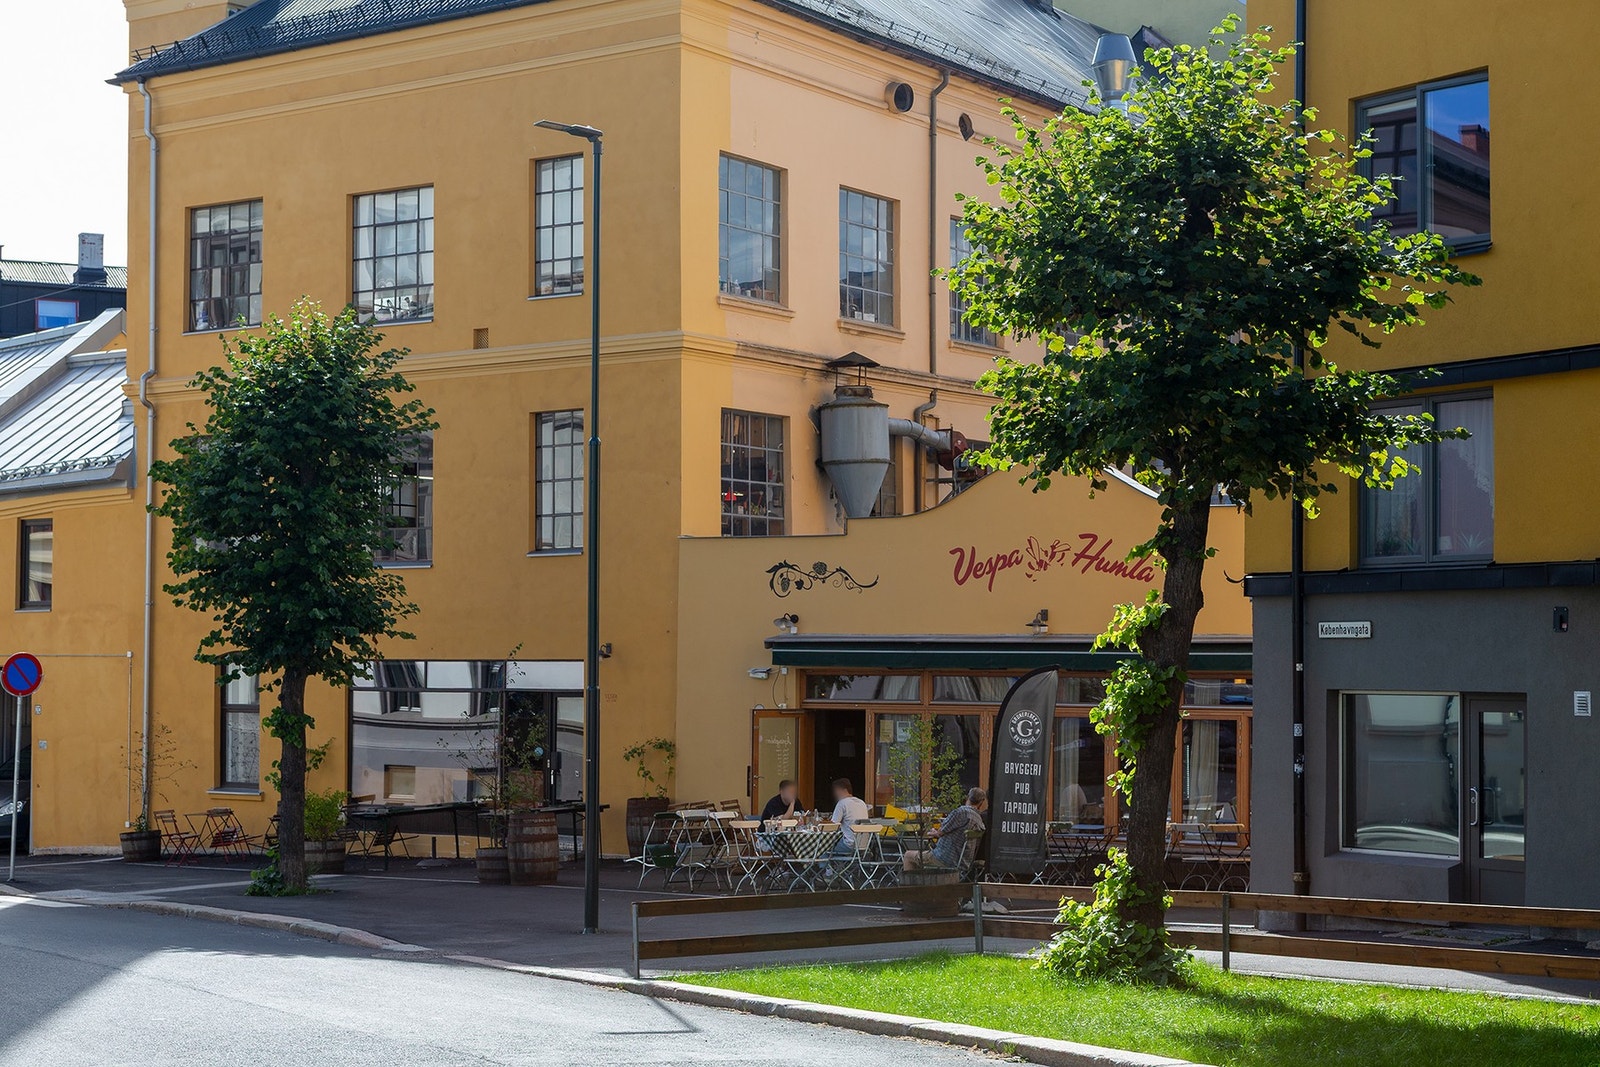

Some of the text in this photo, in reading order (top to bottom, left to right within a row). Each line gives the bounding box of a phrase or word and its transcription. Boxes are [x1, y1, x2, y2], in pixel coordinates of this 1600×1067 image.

[949, 533, 1155, 593] Vespa Humla
[1320, 624, 1369, 637] Københavngata
[1016, 719, 1034, 738] G
[1004, 762, 1042, 776] BRYGGERI
[1014, 782, 1030, 795] PUB
[1003, 801, 1038, 815] TAPROOM
[1001, 820, 1038, 835] ØLUTSALG
